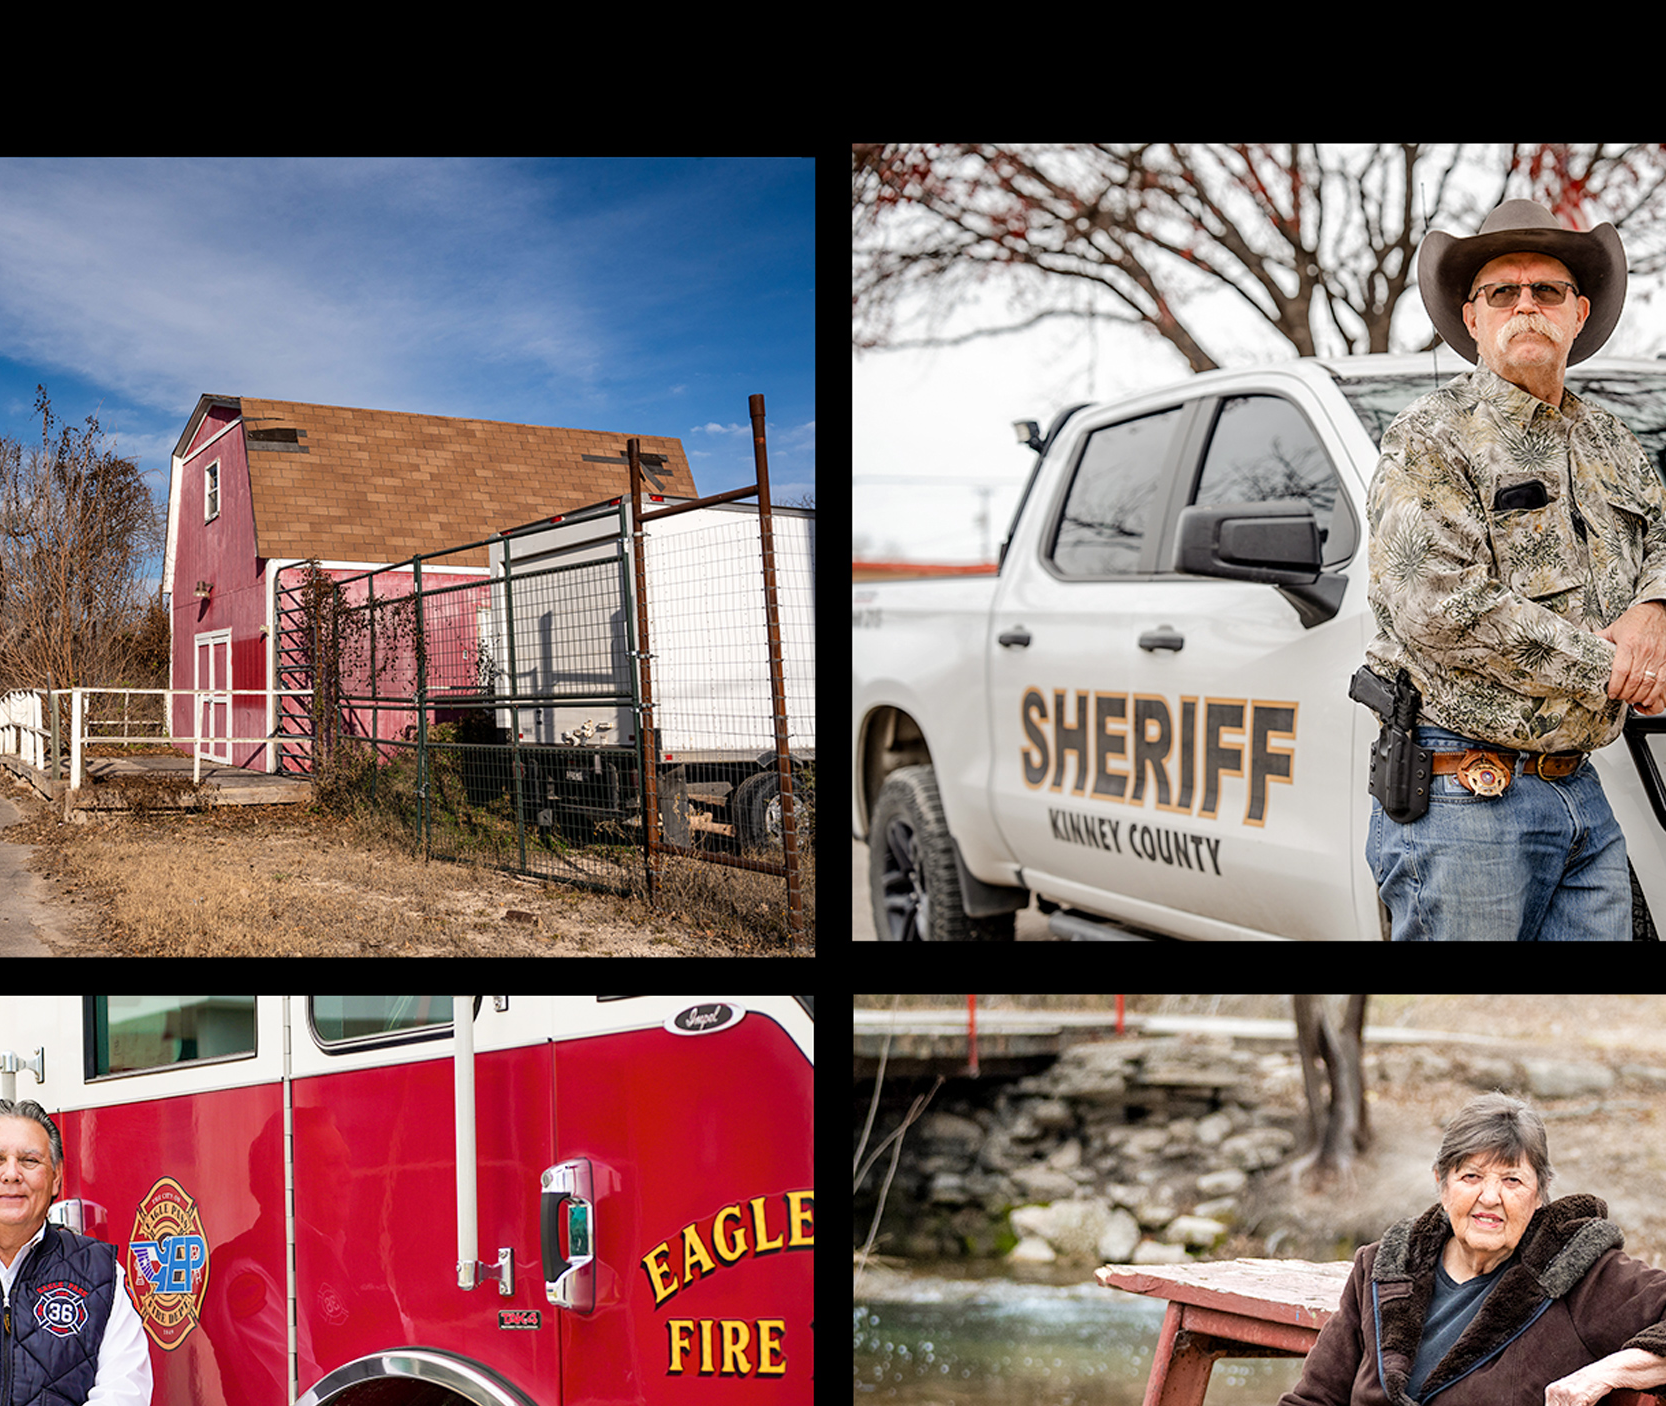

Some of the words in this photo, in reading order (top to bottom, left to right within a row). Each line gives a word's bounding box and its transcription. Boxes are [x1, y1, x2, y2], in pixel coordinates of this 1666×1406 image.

[1020, 685, 1299, 828] SHERIFF
[1048, 807, 1123, 854] KINNEY
[1129, 823, 1222, 876] COUNTY
[171, 1204, 188, 1230] PASS
[640, 1190, 814, 1310] EAGLE
[49, 1303, 73, 1323] 36
[666, 1318, 787, 1379] FIRE
